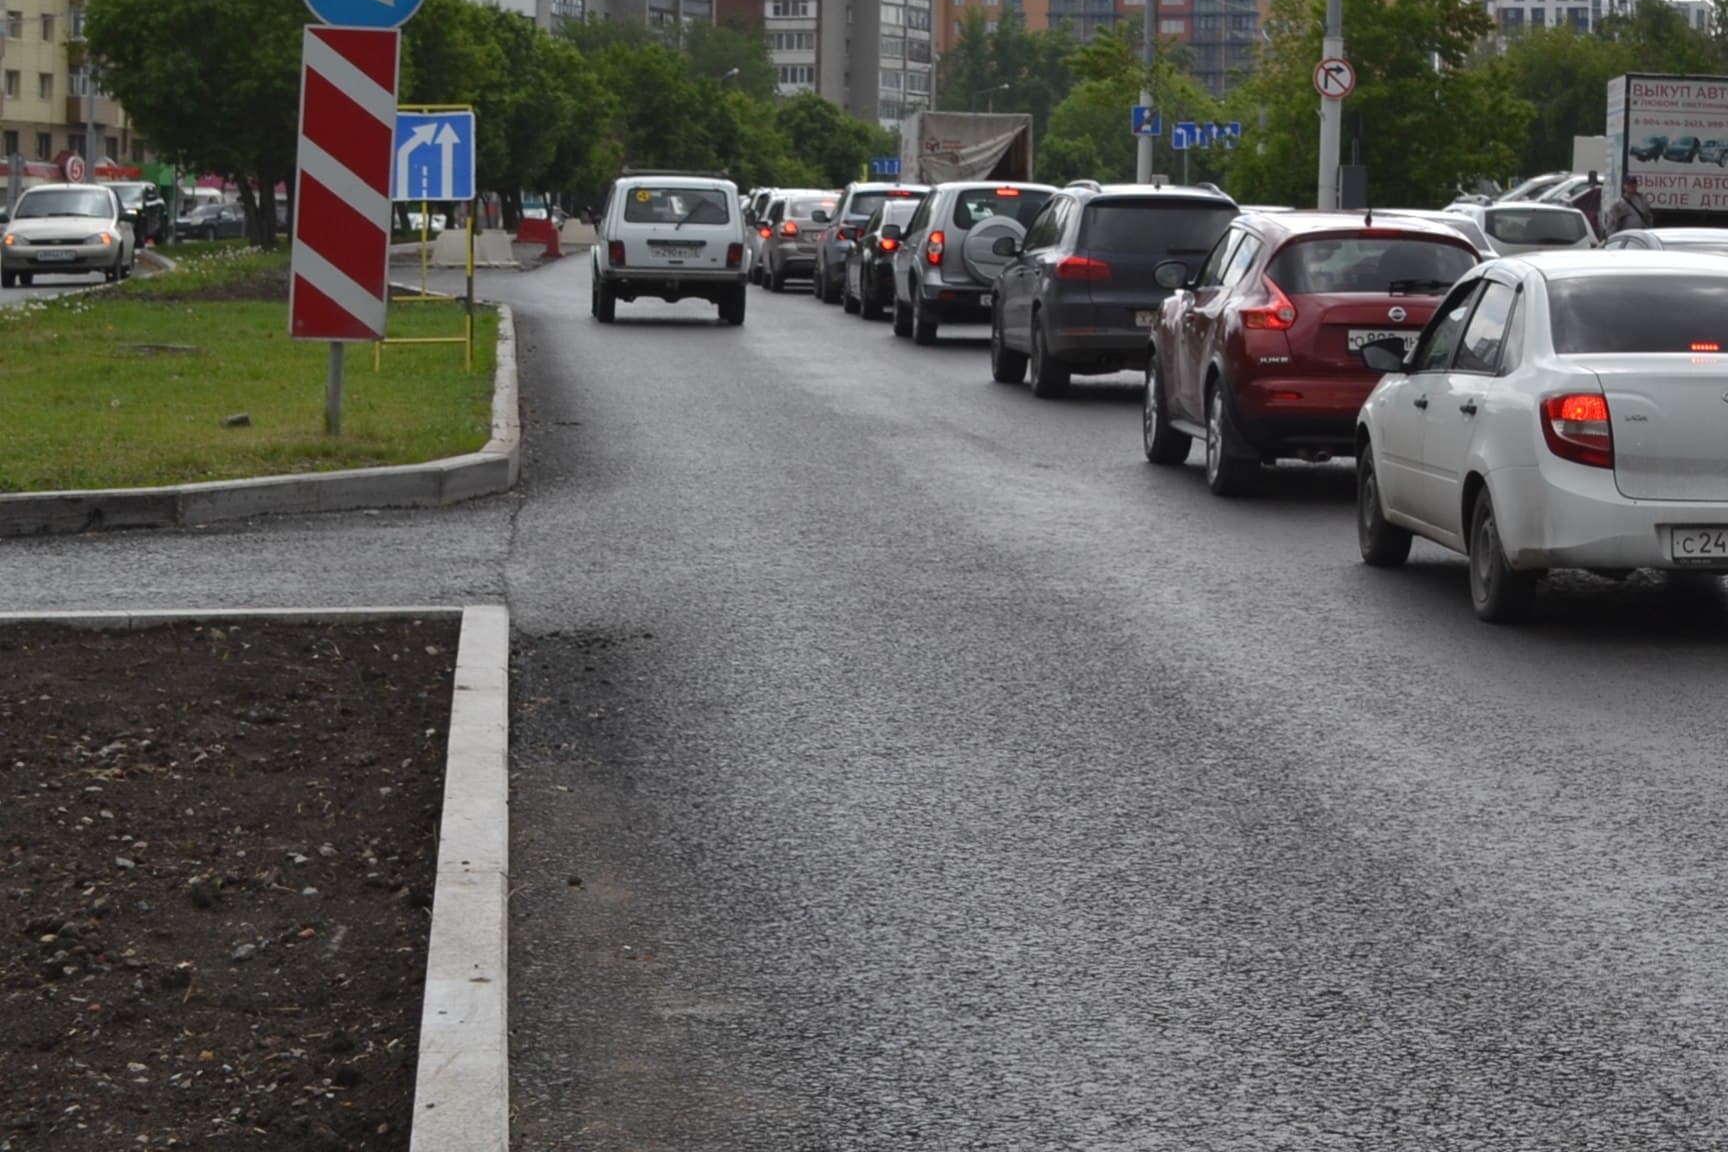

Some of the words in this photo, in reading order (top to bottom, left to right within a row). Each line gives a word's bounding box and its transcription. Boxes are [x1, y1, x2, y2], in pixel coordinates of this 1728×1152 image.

[1632, 84, 1691, 98] ВЫКУП
[1635, 176, 1687, 188] ВЫКУП
[1646, 192, 1689, 206] ОСЛЕ
